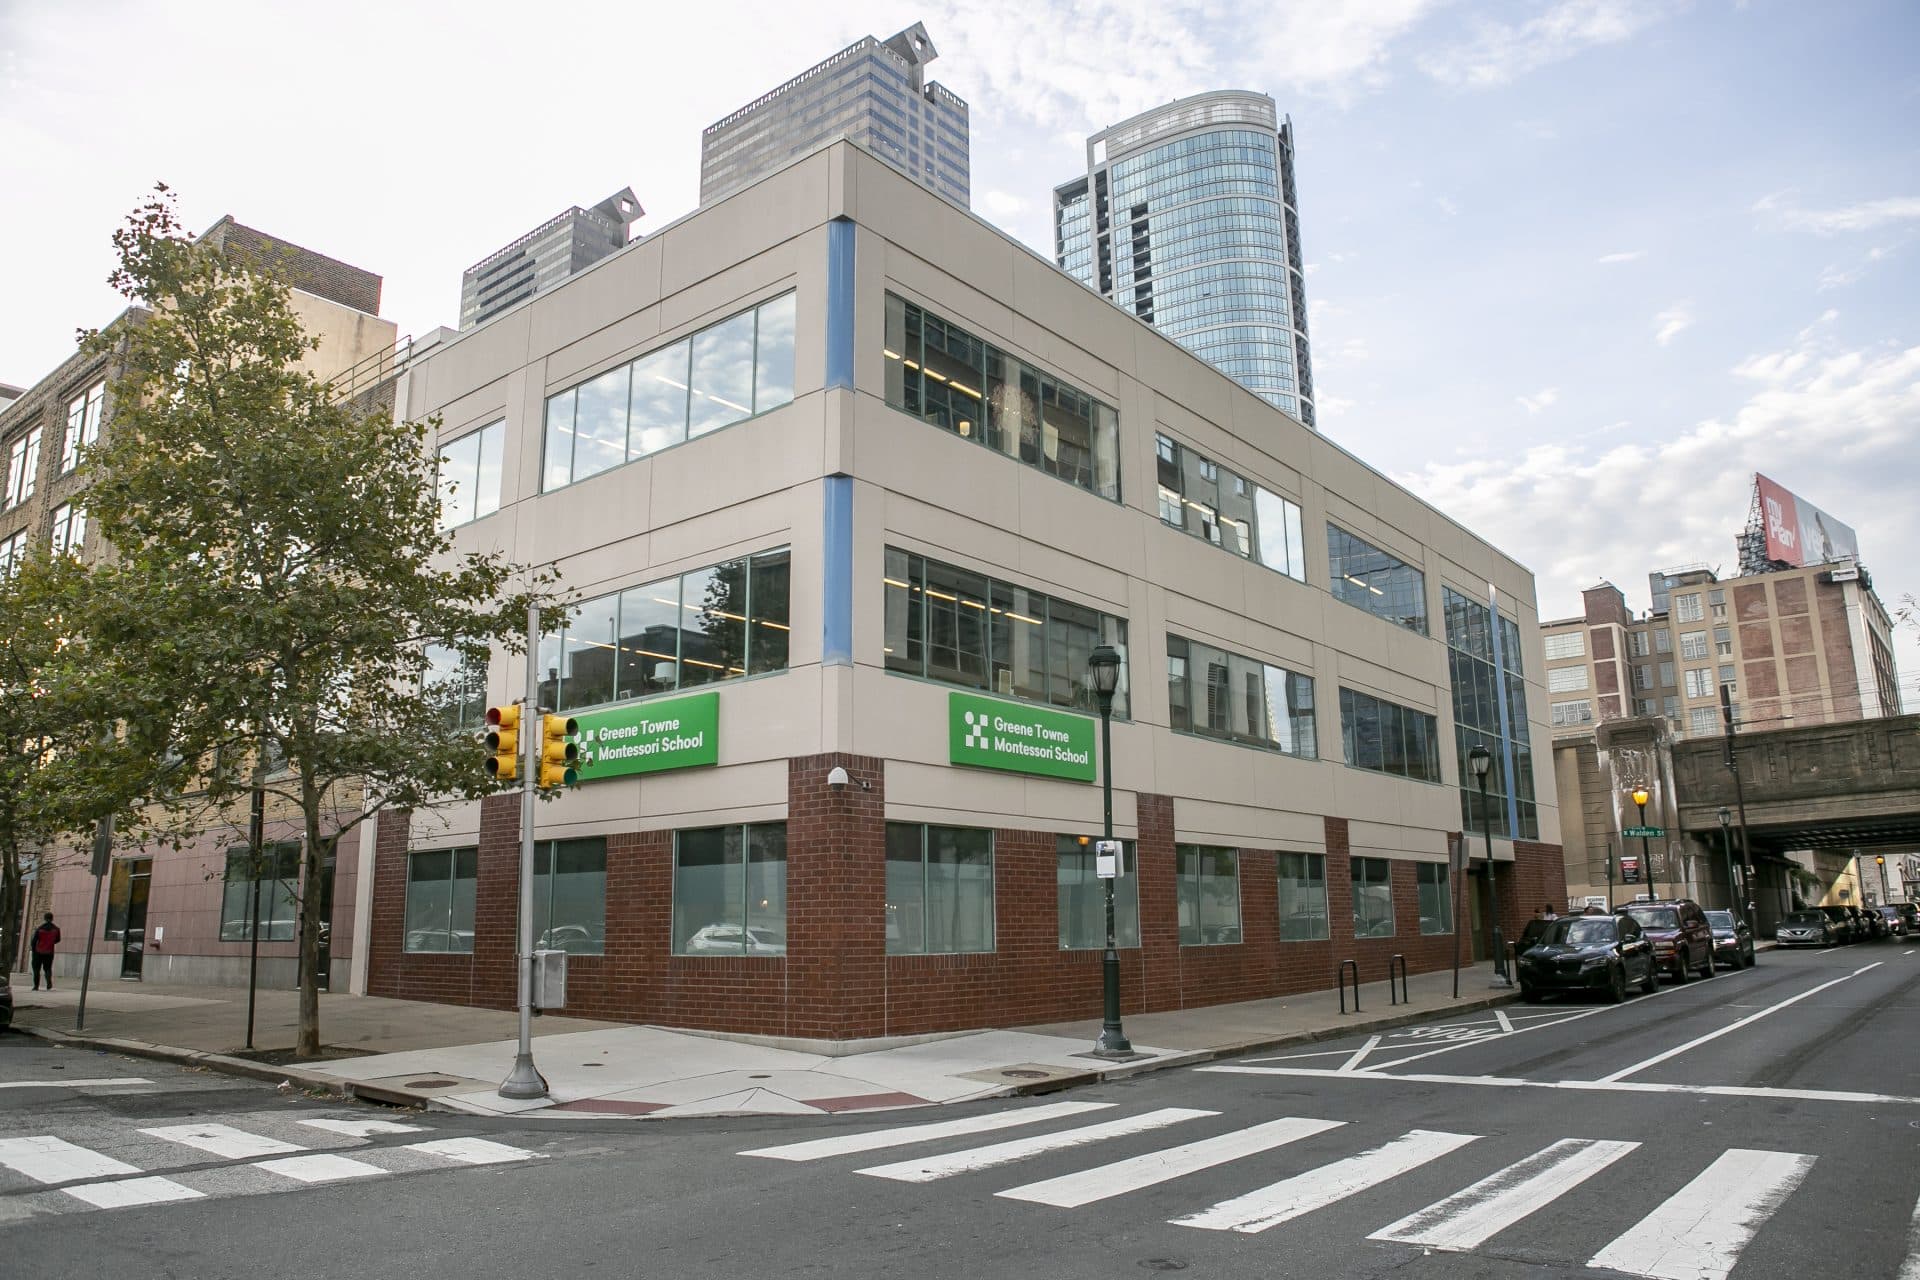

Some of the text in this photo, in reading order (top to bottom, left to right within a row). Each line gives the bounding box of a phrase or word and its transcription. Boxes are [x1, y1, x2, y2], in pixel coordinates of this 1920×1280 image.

[599, 718, 680, 741] Greene Towne
[994, 716, 1069, 743] Greene Towne
[598, 731, 703, 761] Montessori School
[994, 736, 1088, 764] Montessori School
